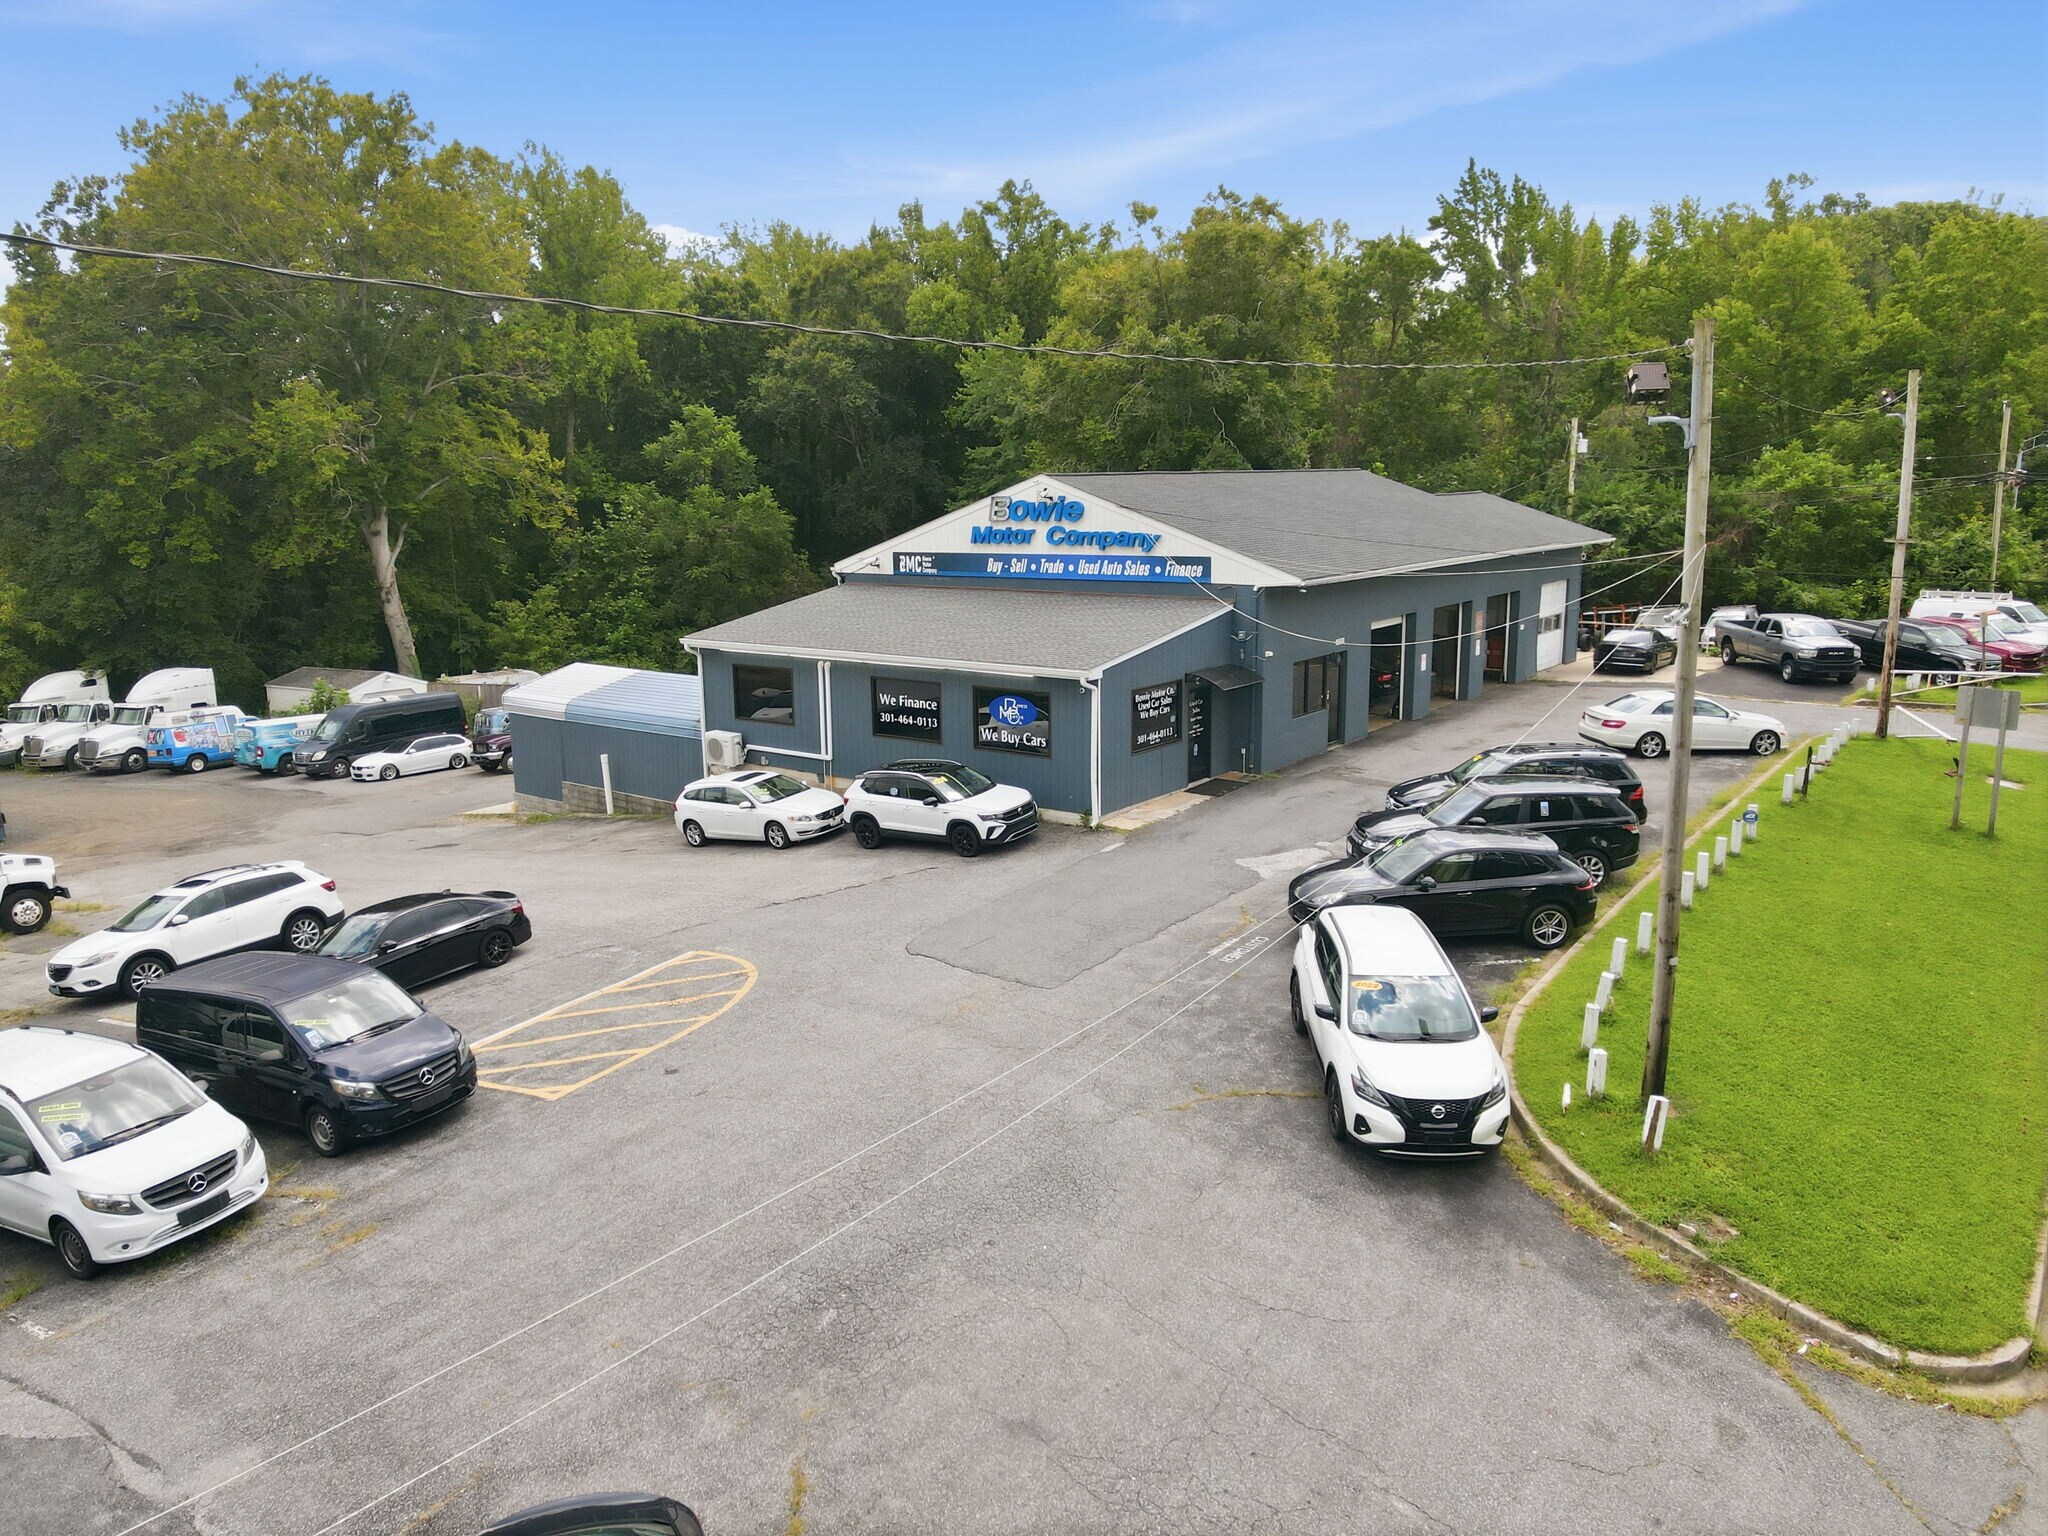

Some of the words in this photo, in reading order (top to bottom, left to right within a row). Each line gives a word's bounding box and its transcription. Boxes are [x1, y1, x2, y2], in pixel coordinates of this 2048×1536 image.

[988, 495, 1085, 522] Bowie
[970, 526, 1036, 545] Motor
[1046, 525, 1162, 552] Company
[899, 555, 921, 573] BMC
[986, 557, 1003, 575] Buy
[1010, 558, 1028, 573] Sell
[1040, 558, 1064, 574] Trade
[1077, 559, 1100, 575] Used
[1100, 559, 1123, 575] Auto
[1123, 560, 1150, 576] Sales
[1164, 561, 1203, 577] Finance
[879, 693, 896, 706] We
[899, 694, 938, 710] Finance
[879, 712, 938, 728] 301-464-0113
[981, 727, 999, 742] We
[1001, 730, 1021, 748] Buy
[1023, 732, 1047, 748] Cars
[1136, 727, 1173, 745] 301-464-0113
